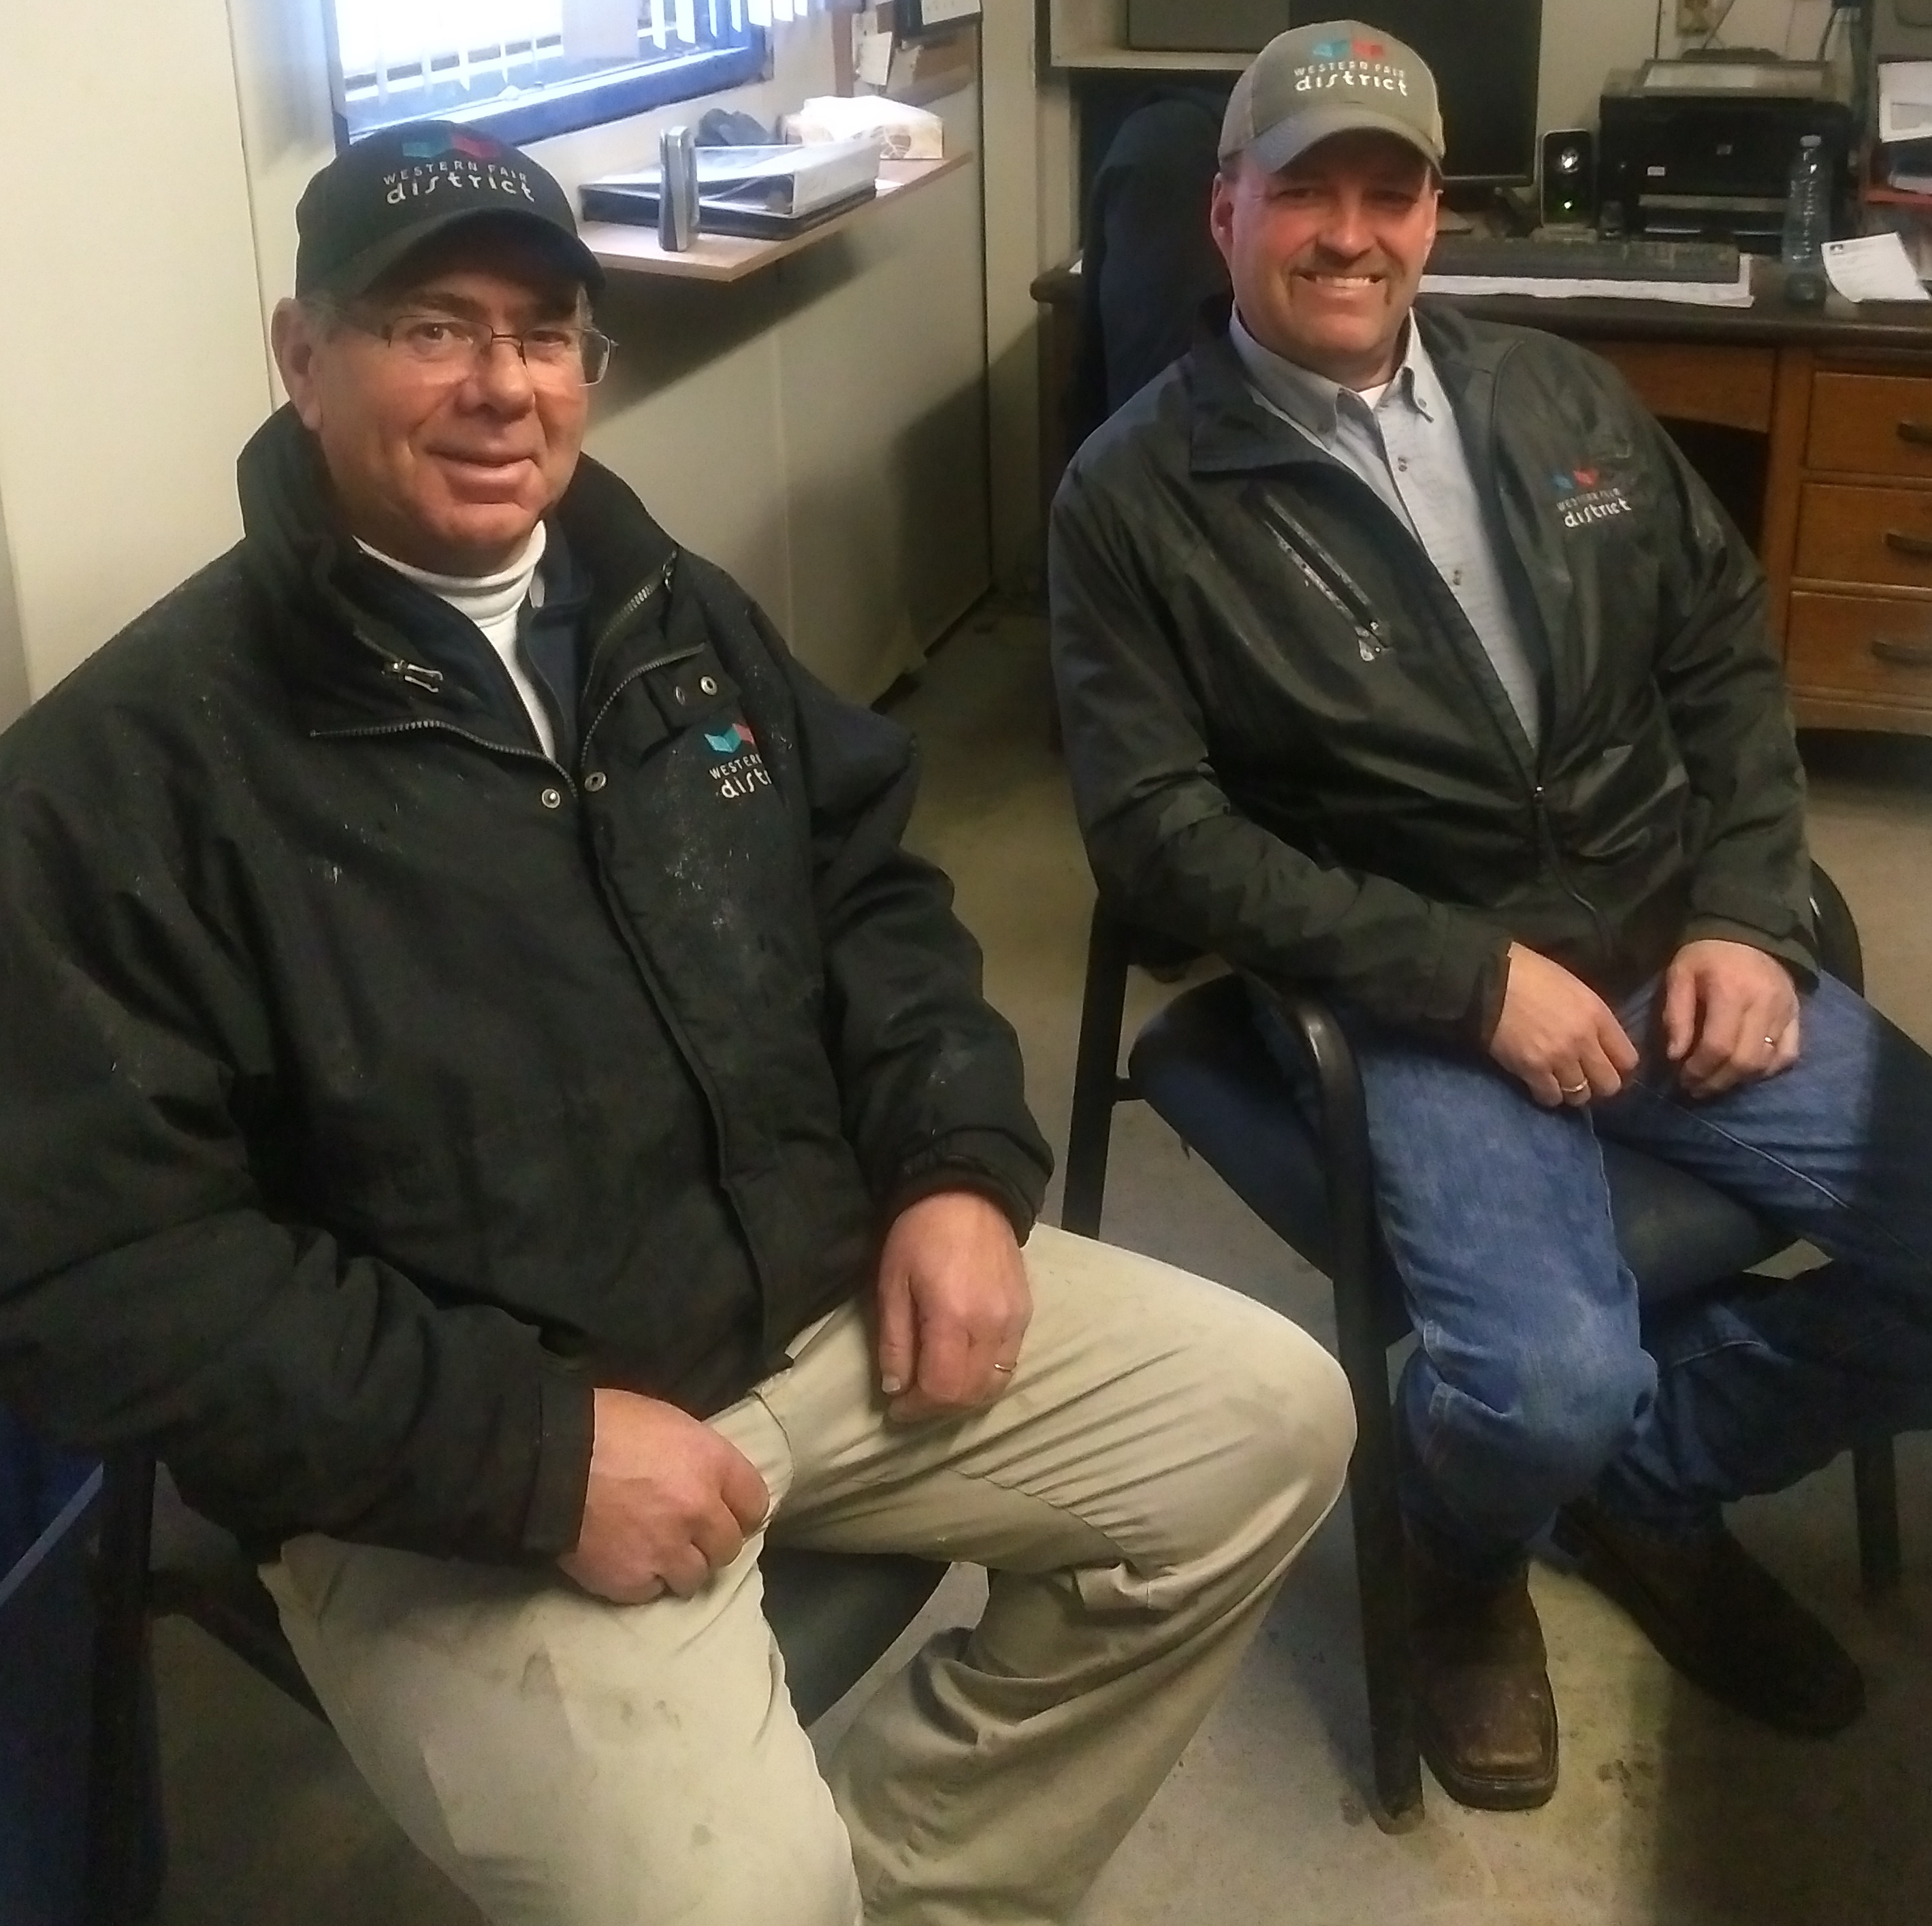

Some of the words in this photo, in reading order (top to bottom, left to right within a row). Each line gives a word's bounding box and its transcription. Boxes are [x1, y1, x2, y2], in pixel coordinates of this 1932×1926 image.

[1295, 71, 1408, 97] district
[383, 160, 478, 185] WESTERN
[487, 164, 527, 182] FAIR
[386, 172, 534, 204] district
[1564, 498, 1632, 528] district
